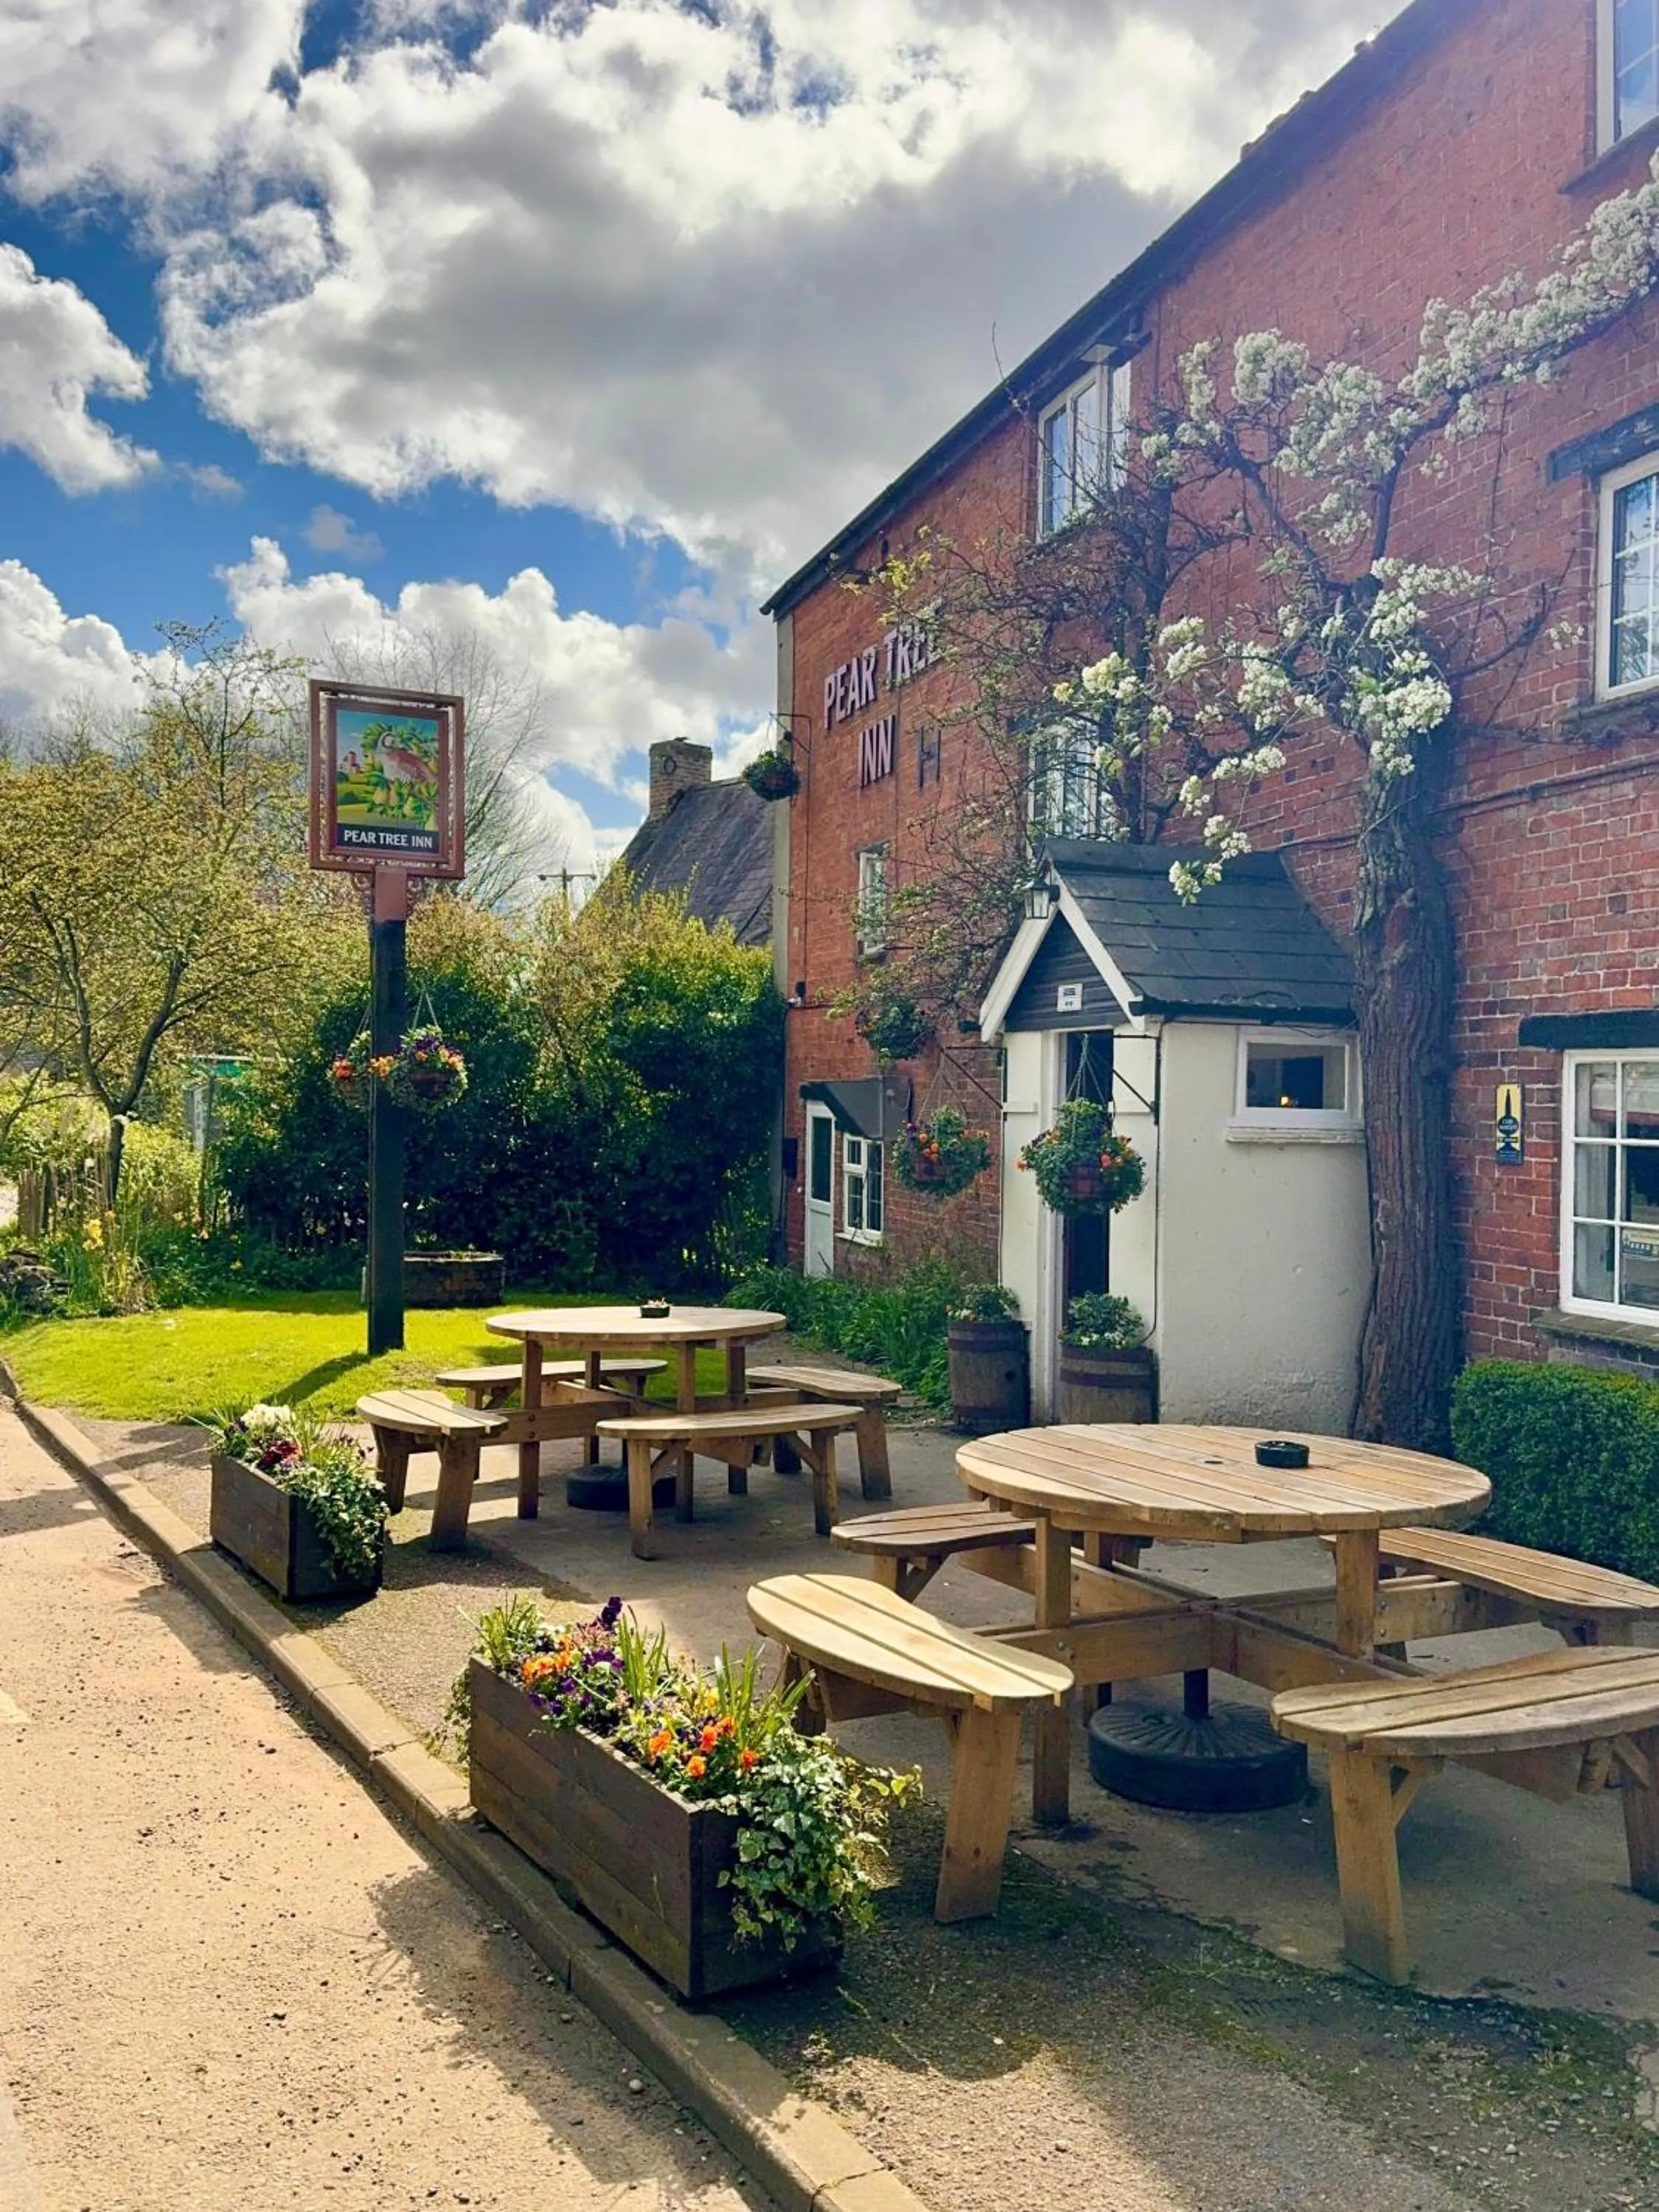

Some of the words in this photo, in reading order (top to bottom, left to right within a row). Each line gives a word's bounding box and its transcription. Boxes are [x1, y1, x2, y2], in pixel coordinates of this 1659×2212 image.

[824, 644, 878, 729] PEAR
[858, 715, 897, 787] INN
[344, 830, 376, 844] PEAR
[378, 832, 409, 846] TREE
[411, 835, 433, 849] INN
